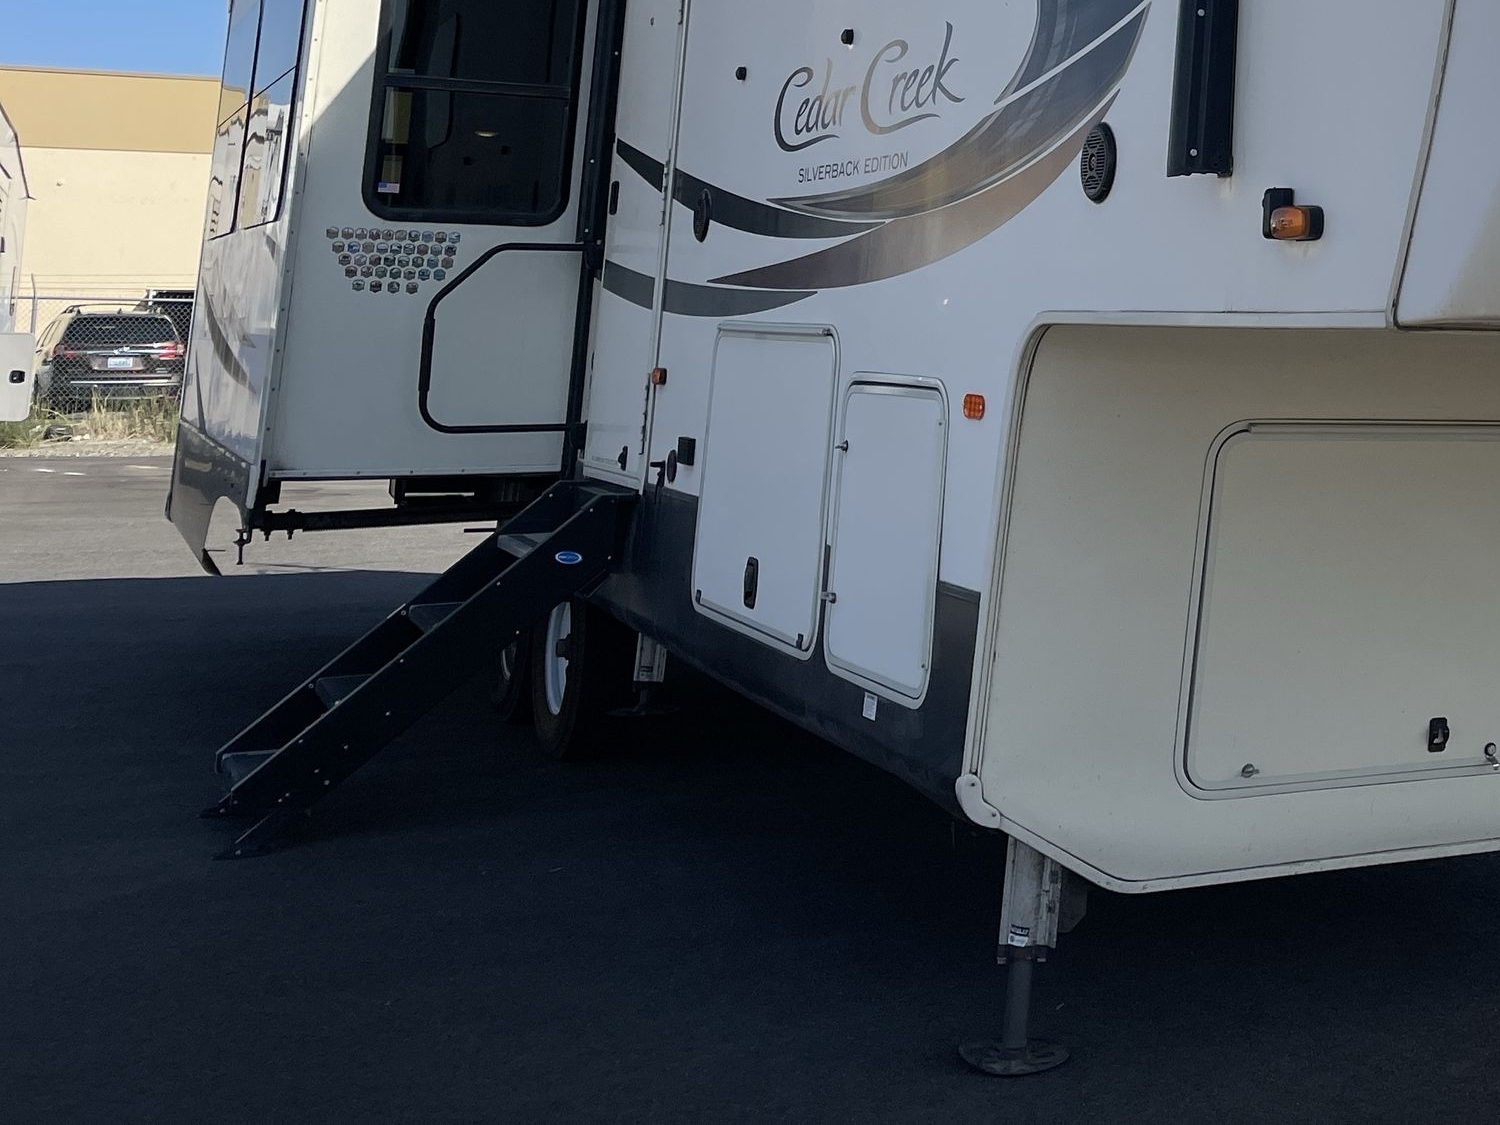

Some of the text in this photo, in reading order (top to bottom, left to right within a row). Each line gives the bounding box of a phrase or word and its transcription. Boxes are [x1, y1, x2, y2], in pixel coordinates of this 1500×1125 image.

[773, 21, 966, 153] Cedar Creek
[798, 151, 909, 183] SILVERBACK EDITION
